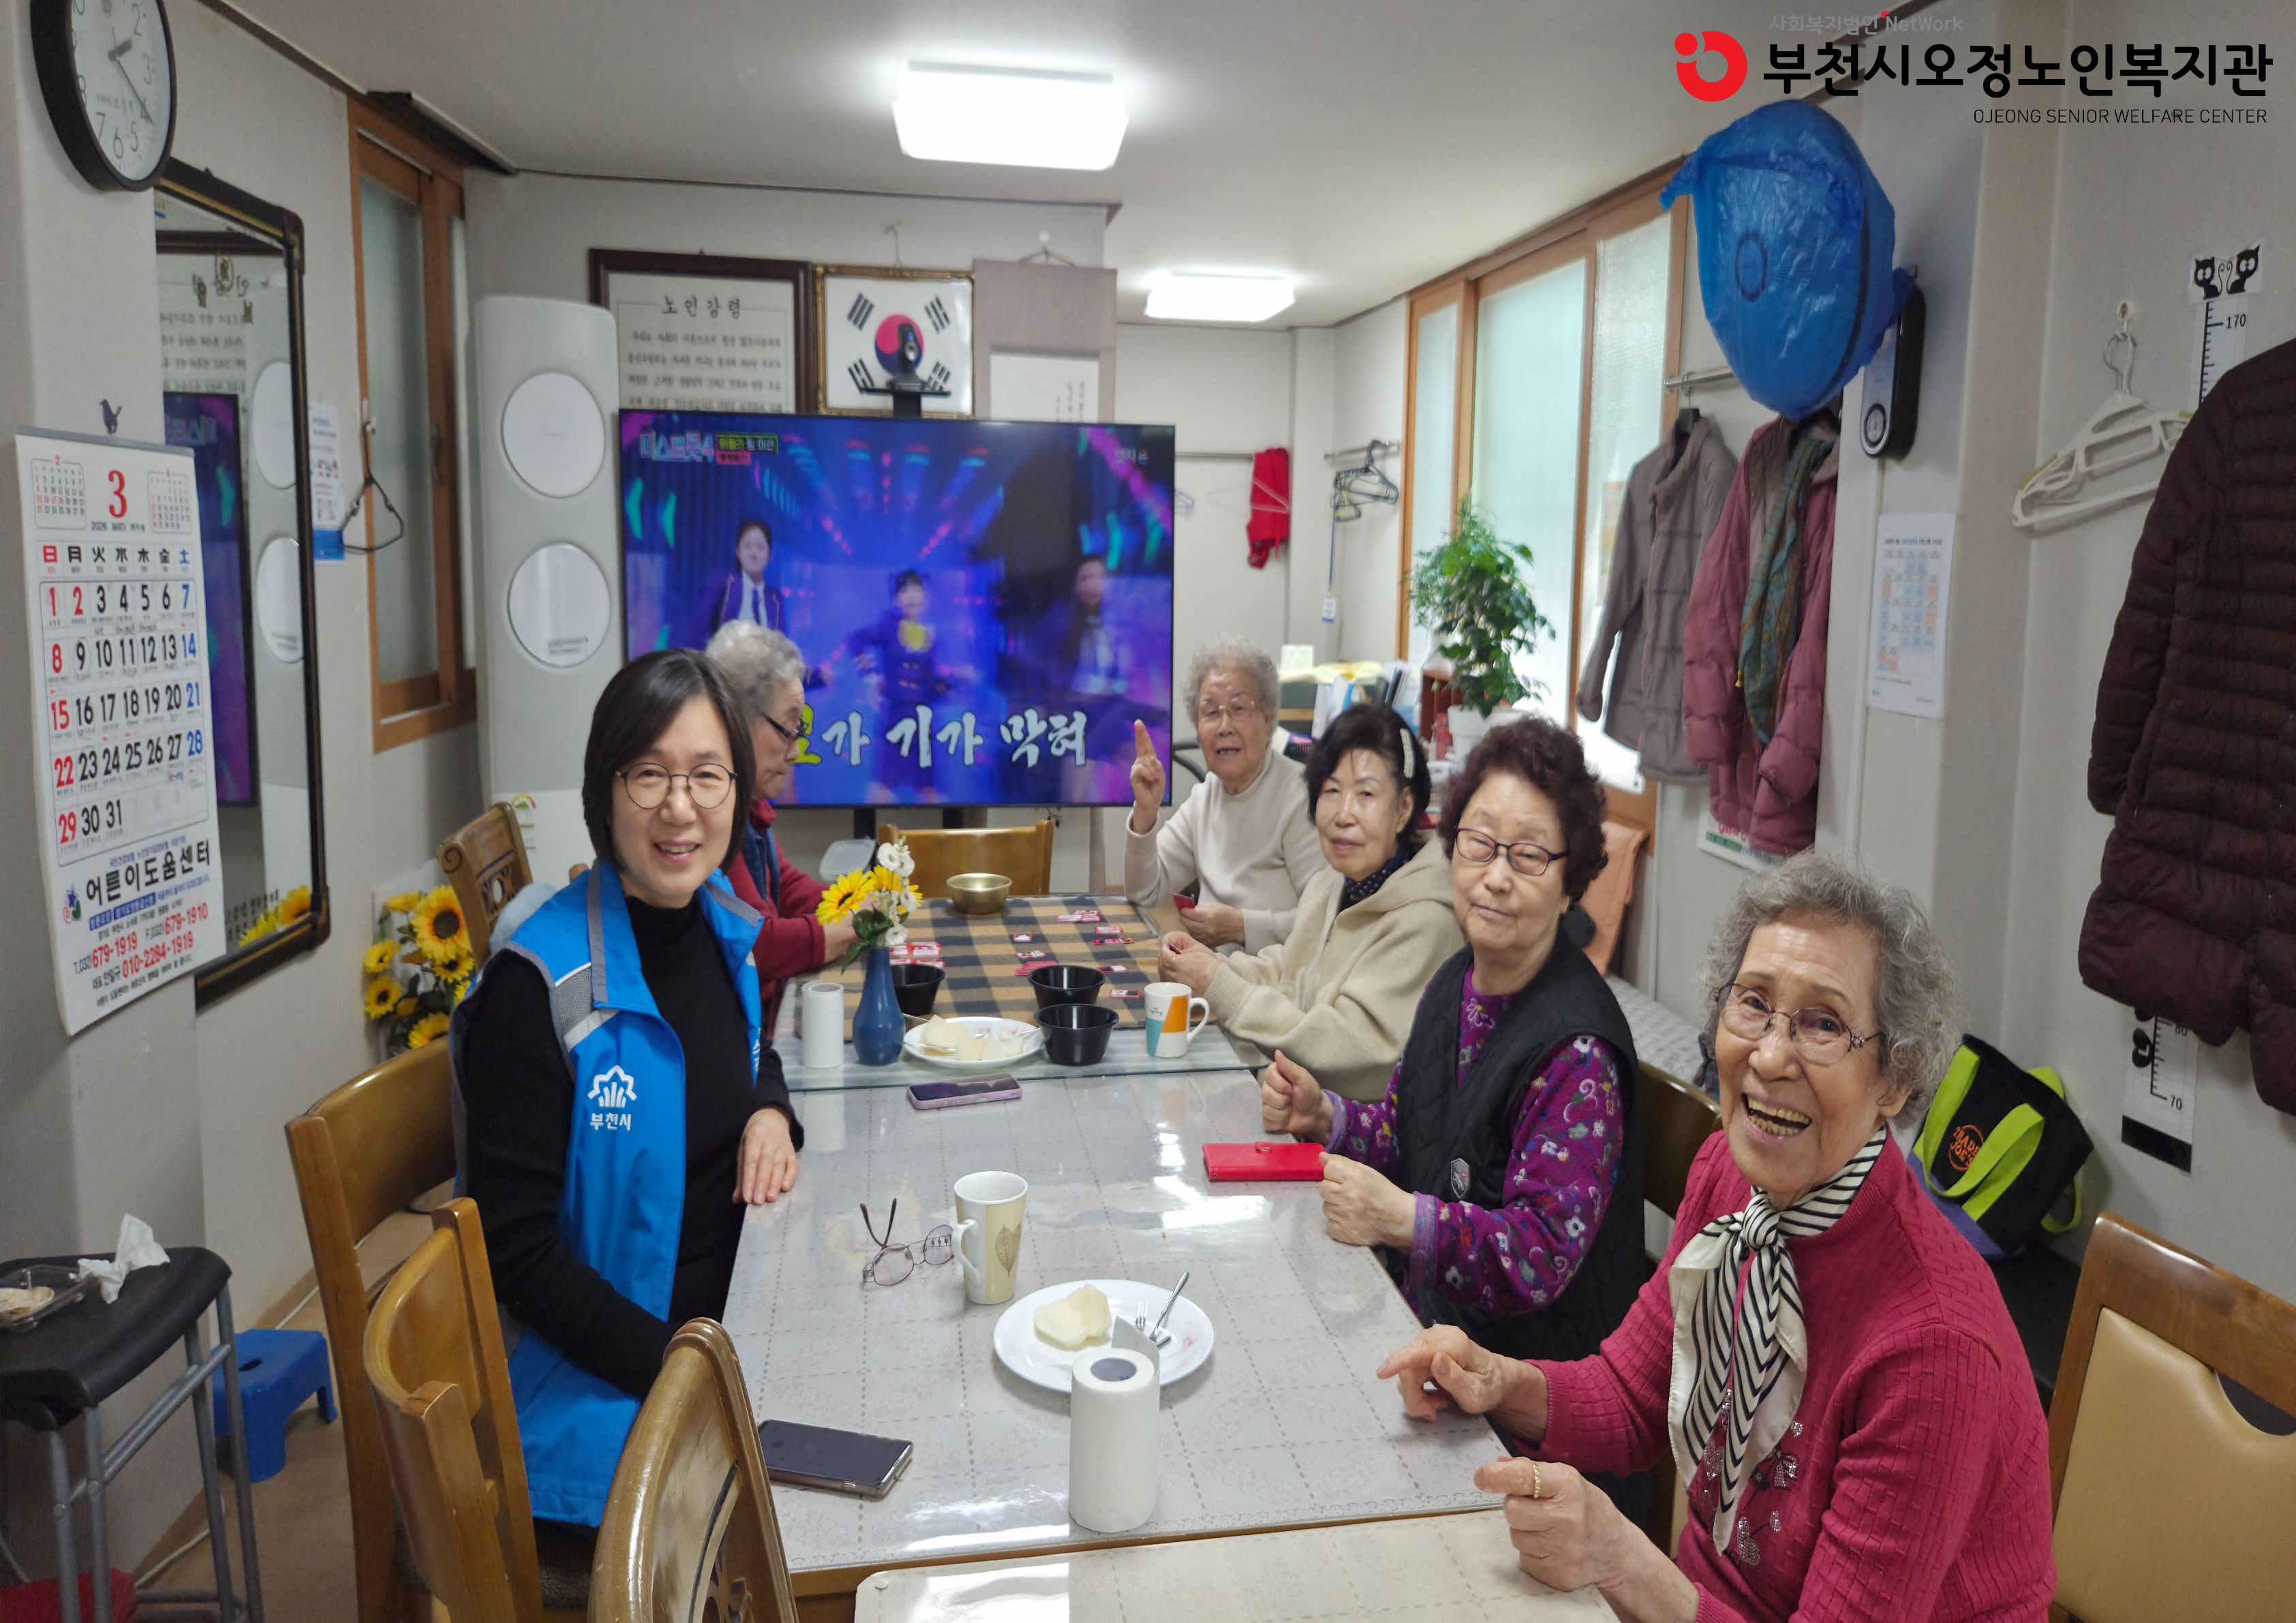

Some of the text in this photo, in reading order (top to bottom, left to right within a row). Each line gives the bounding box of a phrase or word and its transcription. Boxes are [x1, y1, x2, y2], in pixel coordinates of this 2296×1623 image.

[2226, 313, 2246, 329] 170
[108, 470, 128, 519] 3
[43, 545, 189, 563] 日 月 火 水 木 金 土
[50, 584, 189, 617] 1 2 3 4 5 6 7
[52, 633, 196, 673] 8 9 10 11 12 13 14
[51, 682, 200, 730] 15 16 17 18 19 20 21
[887, 705, 983, 767] 기가
[1000, 709, 1087, 768] 막혀
[55, 729, 203, 788] 22 23 24 25 26 27 28
[59, 799, 121, 844] 29 30 31
[86, 839, 210, 906] 어른이도움센터
[590, 1112, 632, 1131] 부천시
[2170, 1095, 2182, 1111] 70
